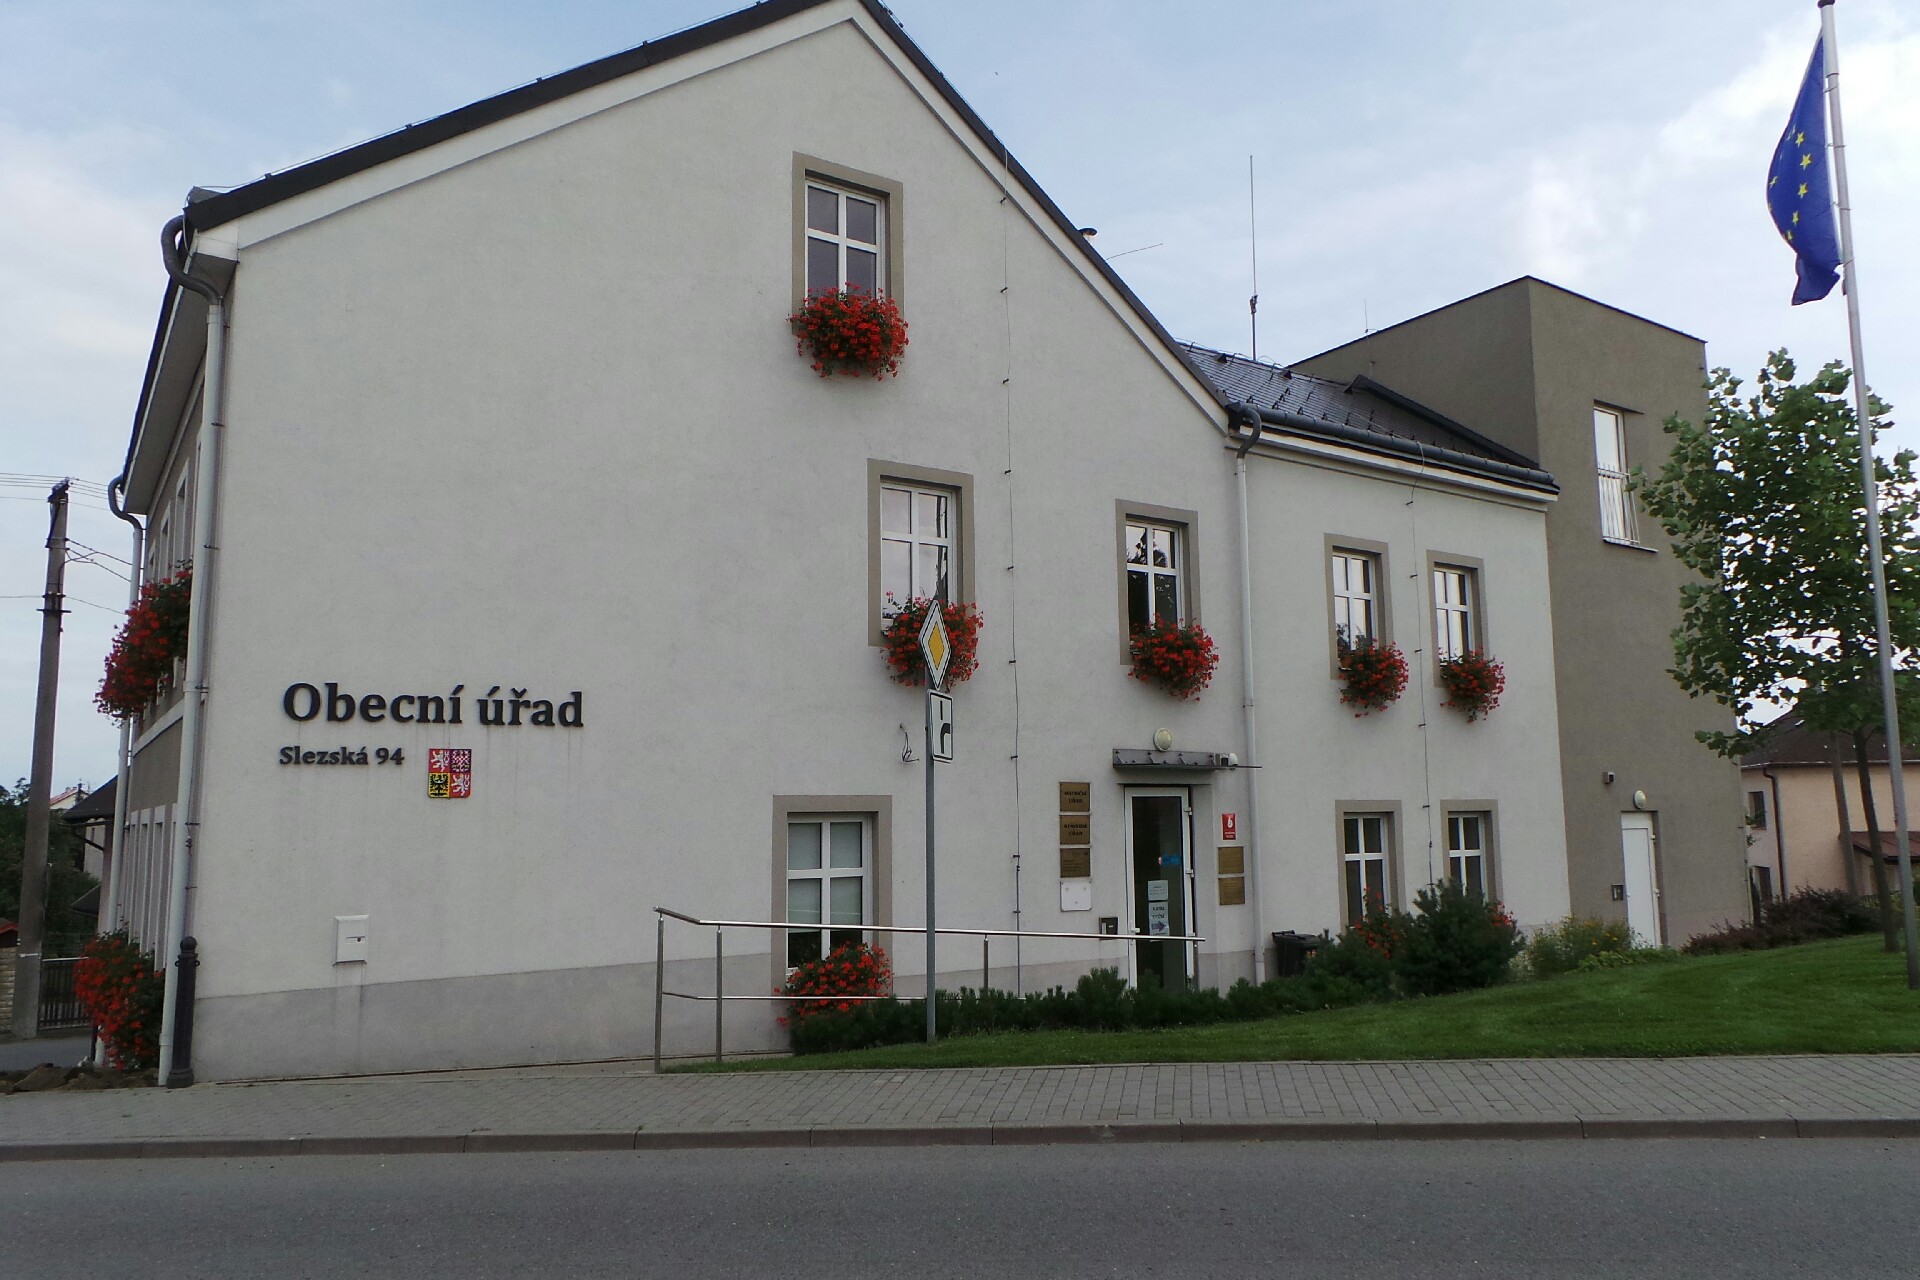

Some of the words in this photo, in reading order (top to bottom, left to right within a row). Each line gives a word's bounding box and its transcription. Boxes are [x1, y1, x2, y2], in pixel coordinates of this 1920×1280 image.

[283, 682, 465, 724] Obecní
[477, 685, 584, 728] úřad
[280, 745, 369, 766] Slezská
[376, 747, 405, 766] 94
